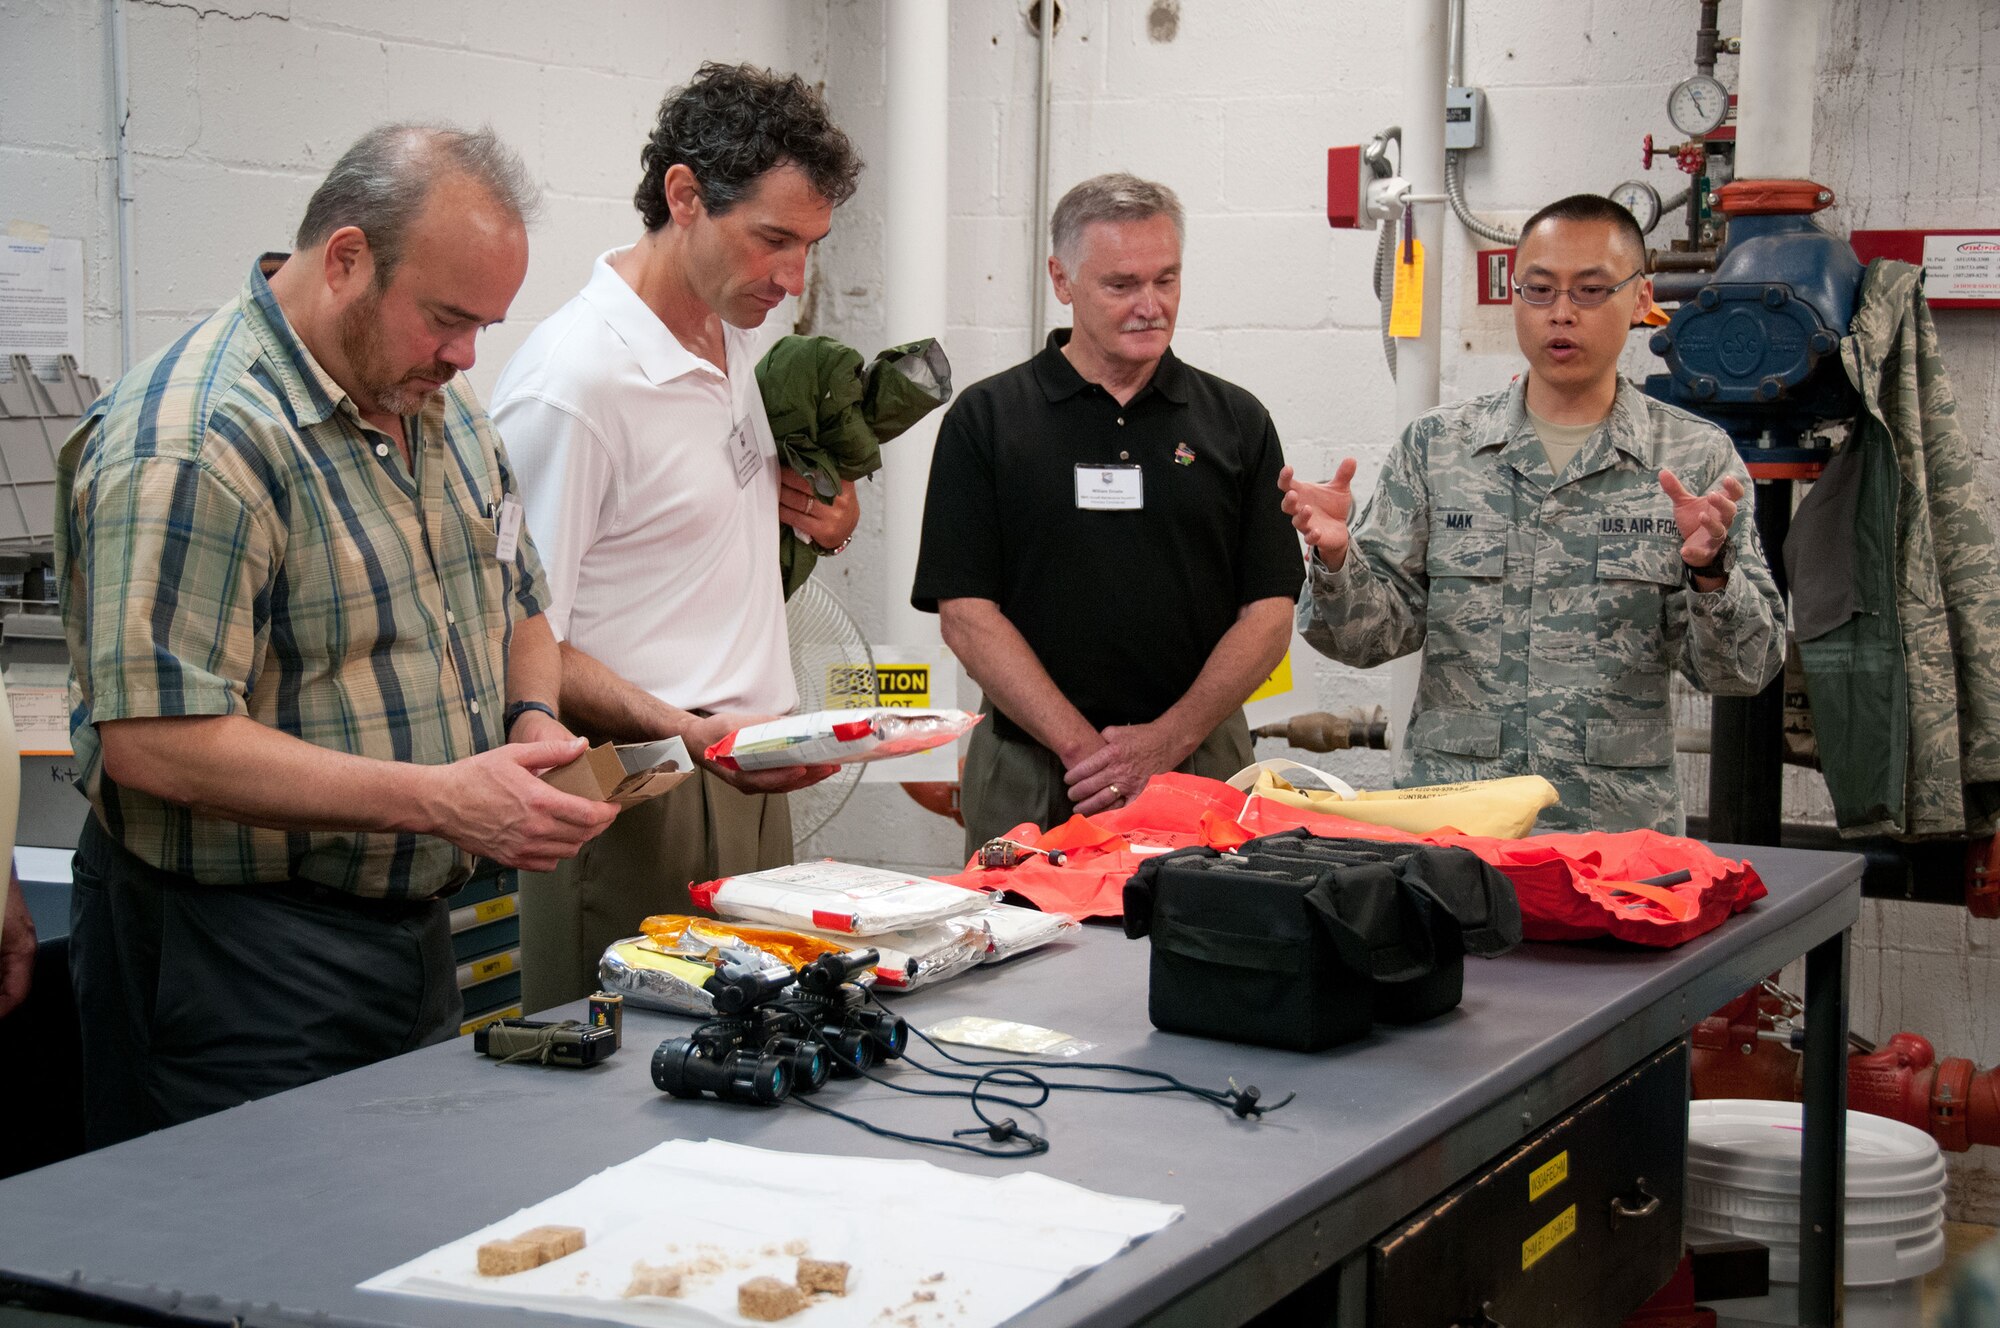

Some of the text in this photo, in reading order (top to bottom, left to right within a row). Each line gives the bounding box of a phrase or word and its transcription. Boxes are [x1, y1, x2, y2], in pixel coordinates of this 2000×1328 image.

[1446, 514, 1473, 529] MAK
[1602, 518, 1626, 533] U.S.
[1629, 518, 1652, 533] AIR
